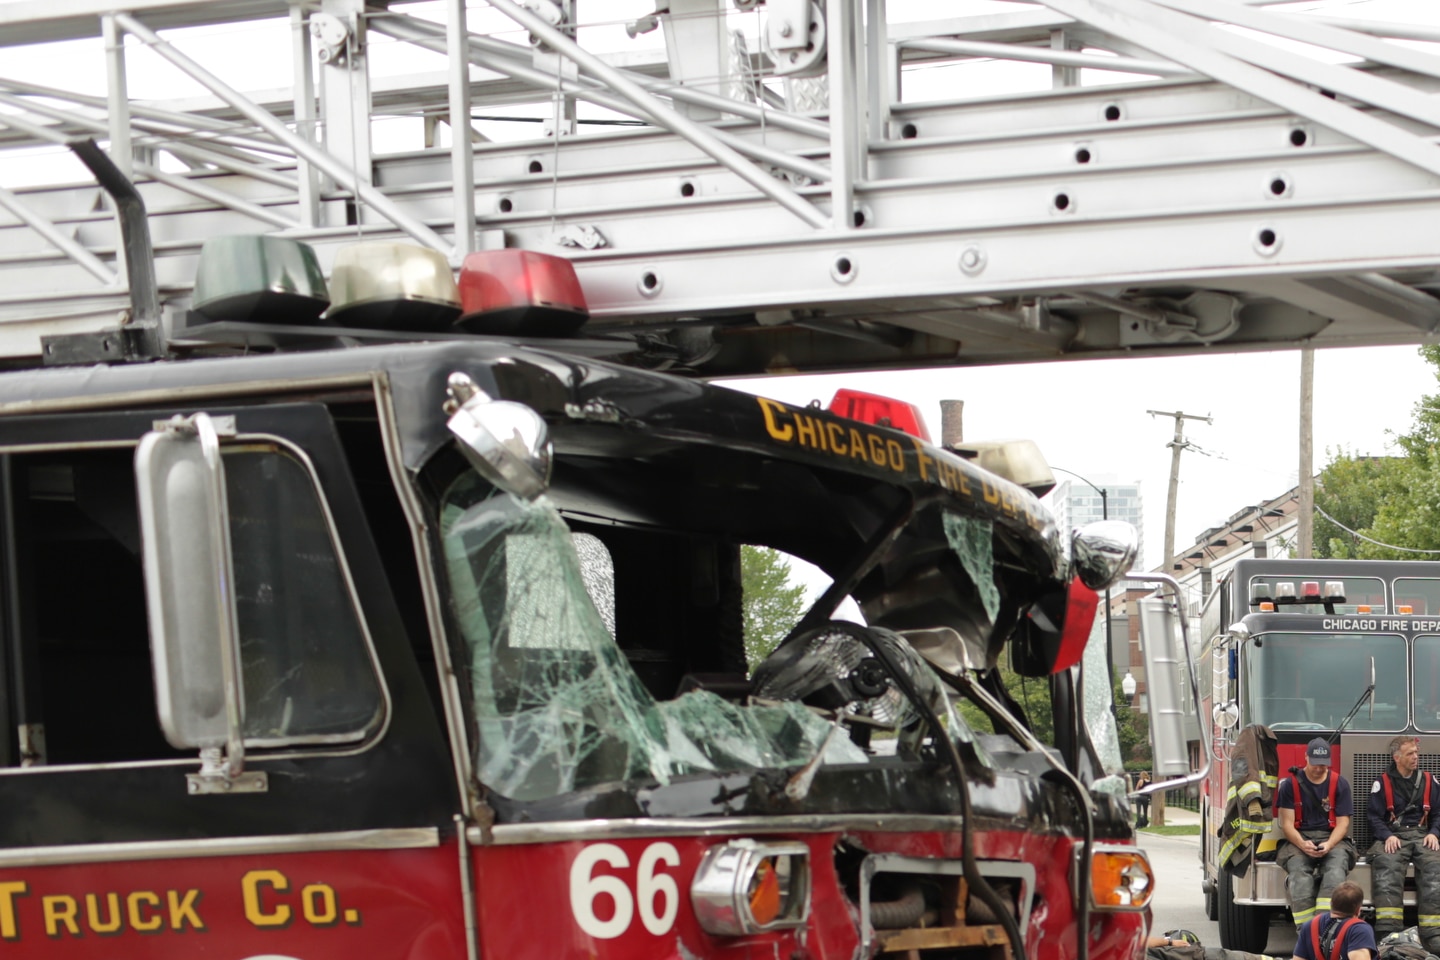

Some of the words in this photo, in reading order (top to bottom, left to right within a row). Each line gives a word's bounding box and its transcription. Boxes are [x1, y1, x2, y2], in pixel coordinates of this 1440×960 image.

[756, 396, 905, 473] CHICAGO
[911, 437, 971, 495] FIRE
[1323, 619, 1377, 631] CHICAGO
[1381, 620, 1408, 631] FIRE
[0, 880, 204, 939] TRUCK
[241, 869, 359, 926] CO.
[569, 841, 681, 939] 66
